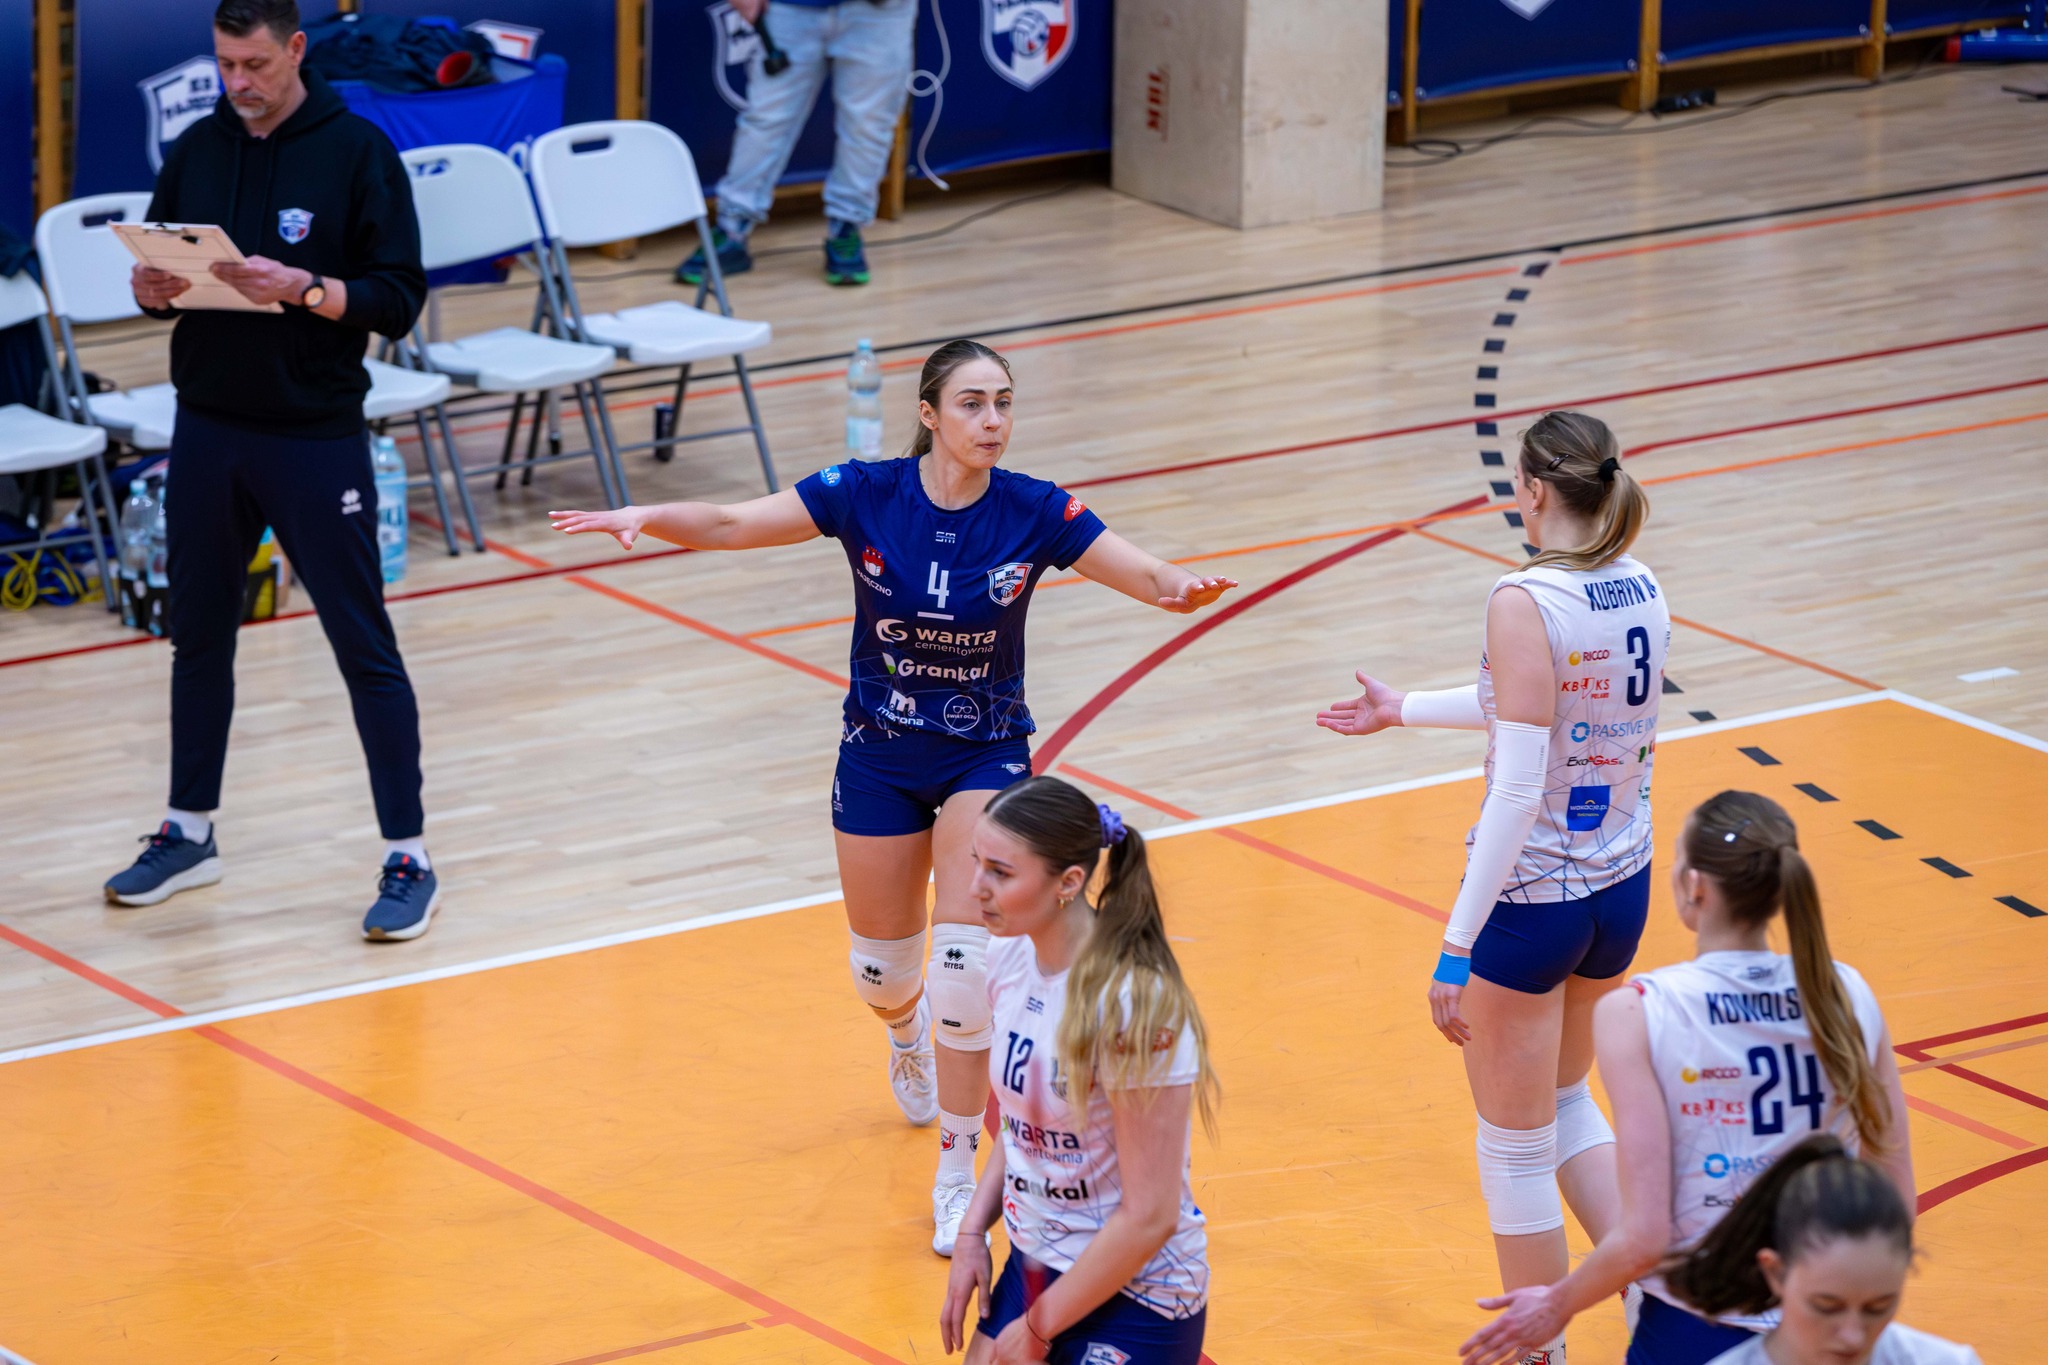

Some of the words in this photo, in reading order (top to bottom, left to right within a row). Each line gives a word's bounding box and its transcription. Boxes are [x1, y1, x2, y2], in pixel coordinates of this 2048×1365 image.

[927, 561, 950, 609] 4
[1583, 577, 1646, 612] KUBRYN
[914, 640, 995, 656] cementownia
[1582, 649, 1610, 662] RICCO
[897, 658, 990, 683] Grankal
[1626, 626, 1651, 707] 3
[876, 706, 924, 726] marona
[1591, 719, 1644, 738] PASSIVE
[1003, 1030, 1034, 1096] 12
[1747, 1043, 1825, 1136] 24
